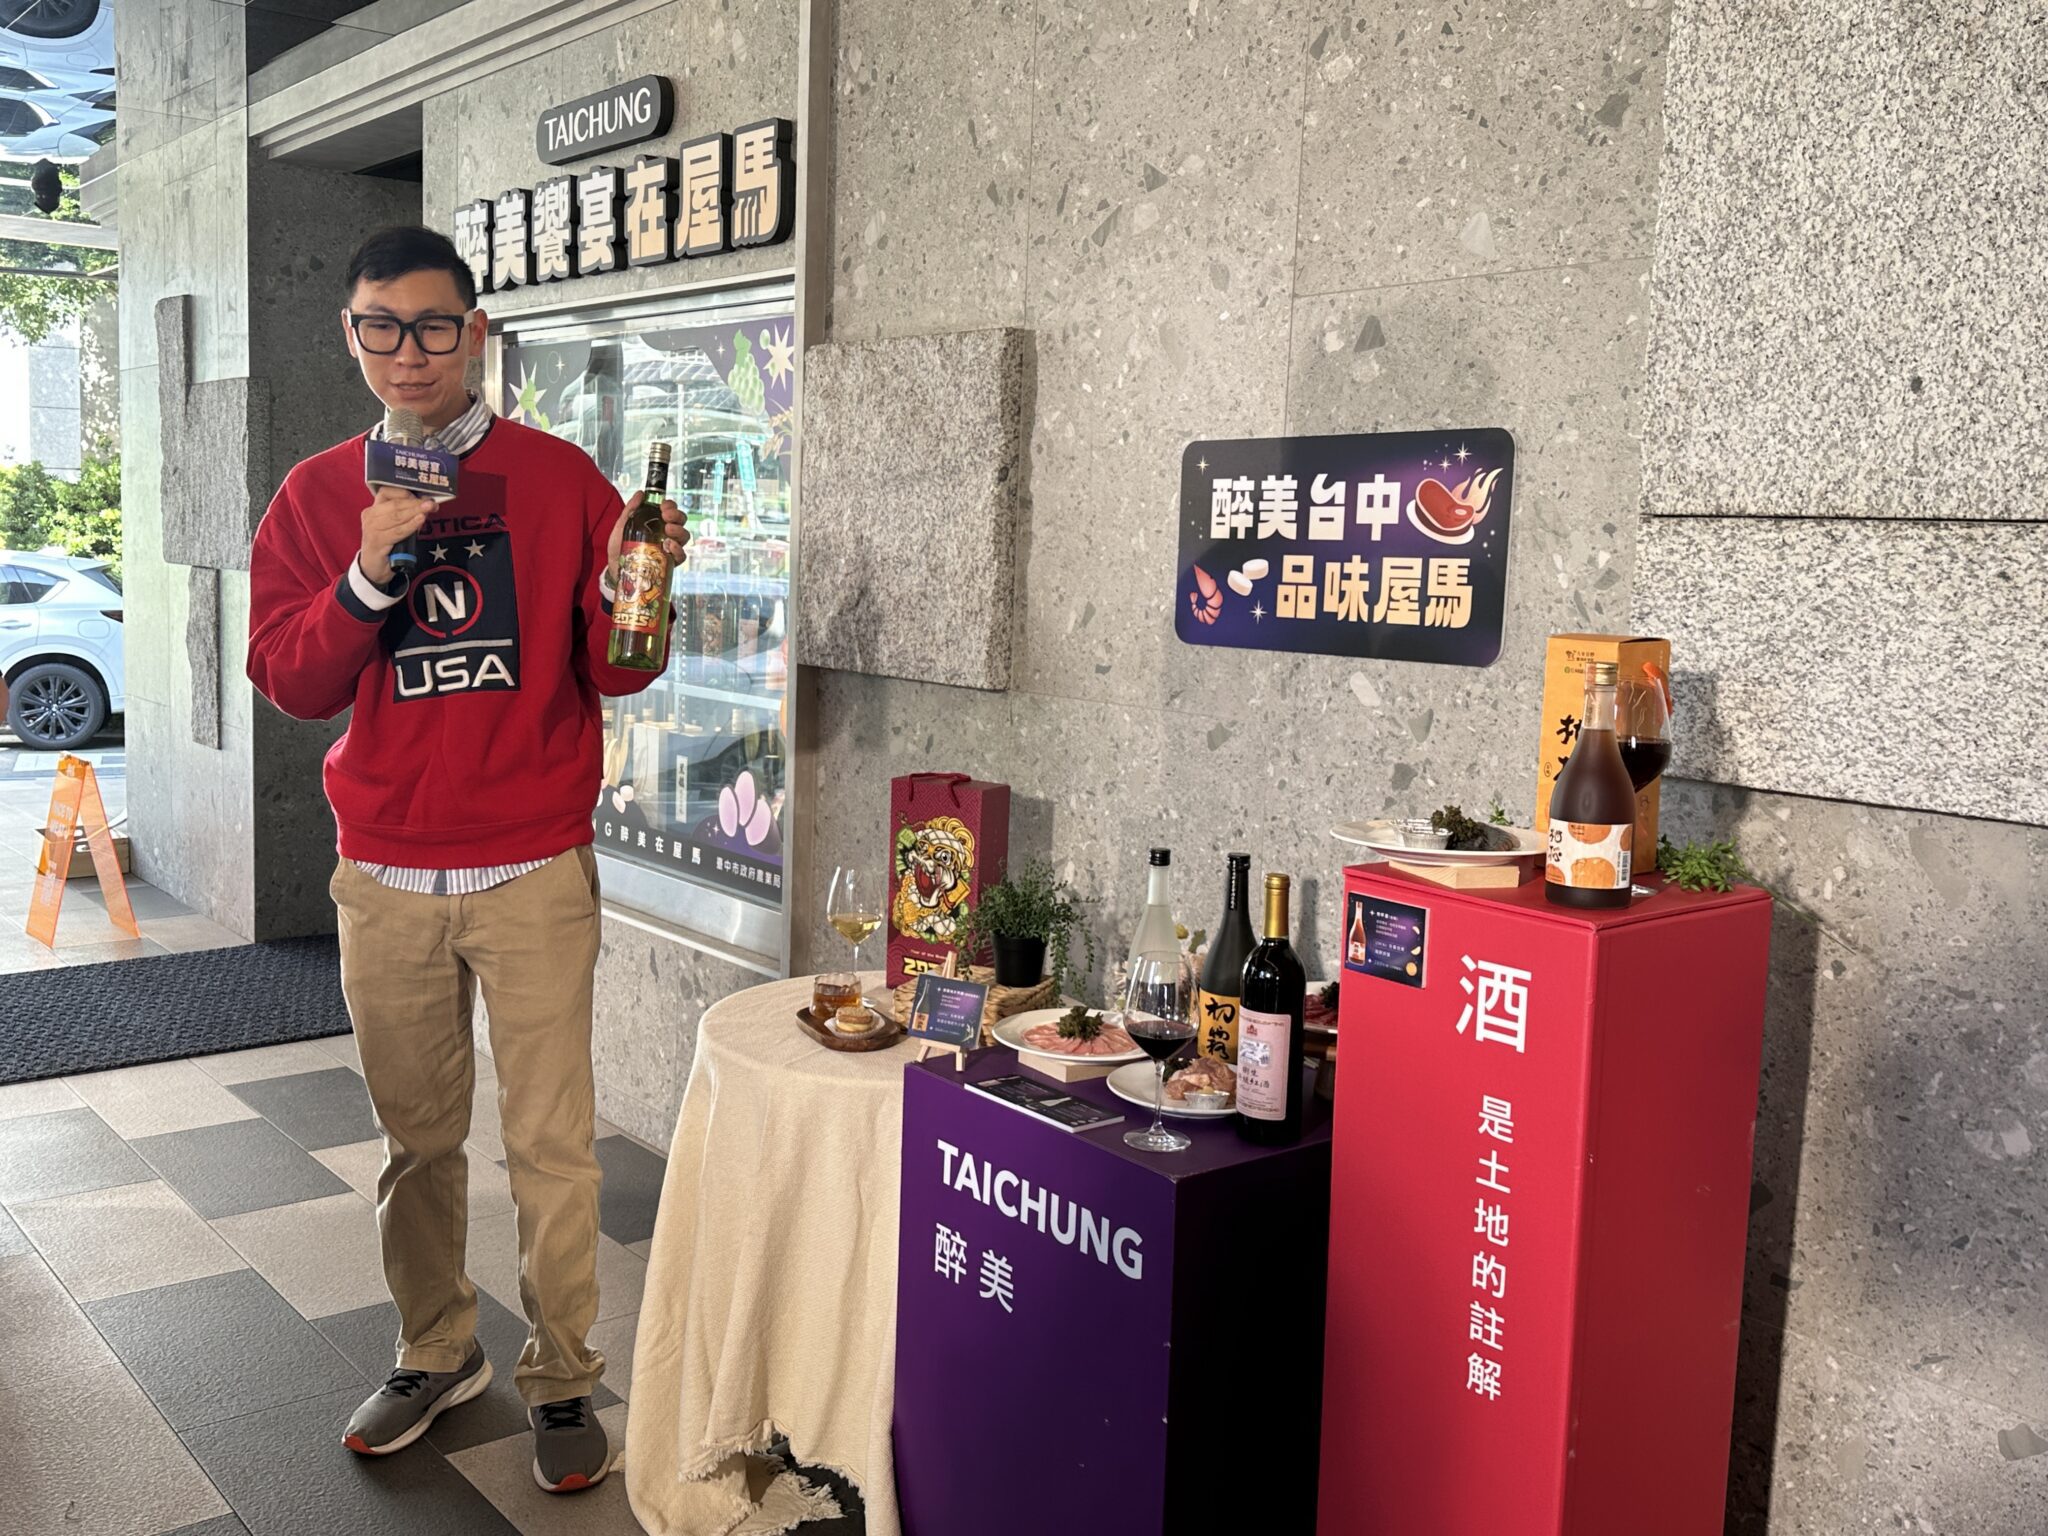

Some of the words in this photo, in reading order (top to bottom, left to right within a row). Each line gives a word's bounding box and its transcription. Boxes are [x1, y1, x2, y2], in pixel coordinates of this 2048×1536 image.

[545, 87, 652, 152] TAICHUNG
[455, 124, 781, 293] 醉美饗宴在屋馬
[1210, 473, 1401, 541] 醉美台中
[423, 580, 467, 622] N
[613, 612, 650, 627] 2025
[1275, 554, 1474, 628] 品味屋馬
[395, 653, 516, 697] USA
[620, 825, 702, 865] 醉美在屋馬
[1455, 954, 1532, 1054] 酒
[937, 1139, 1144, 1280] TAICHUNG
[934, 1222, 1014, 1314] 醉美
[1466, 1094, 1514, 1402] 是土地的註解
